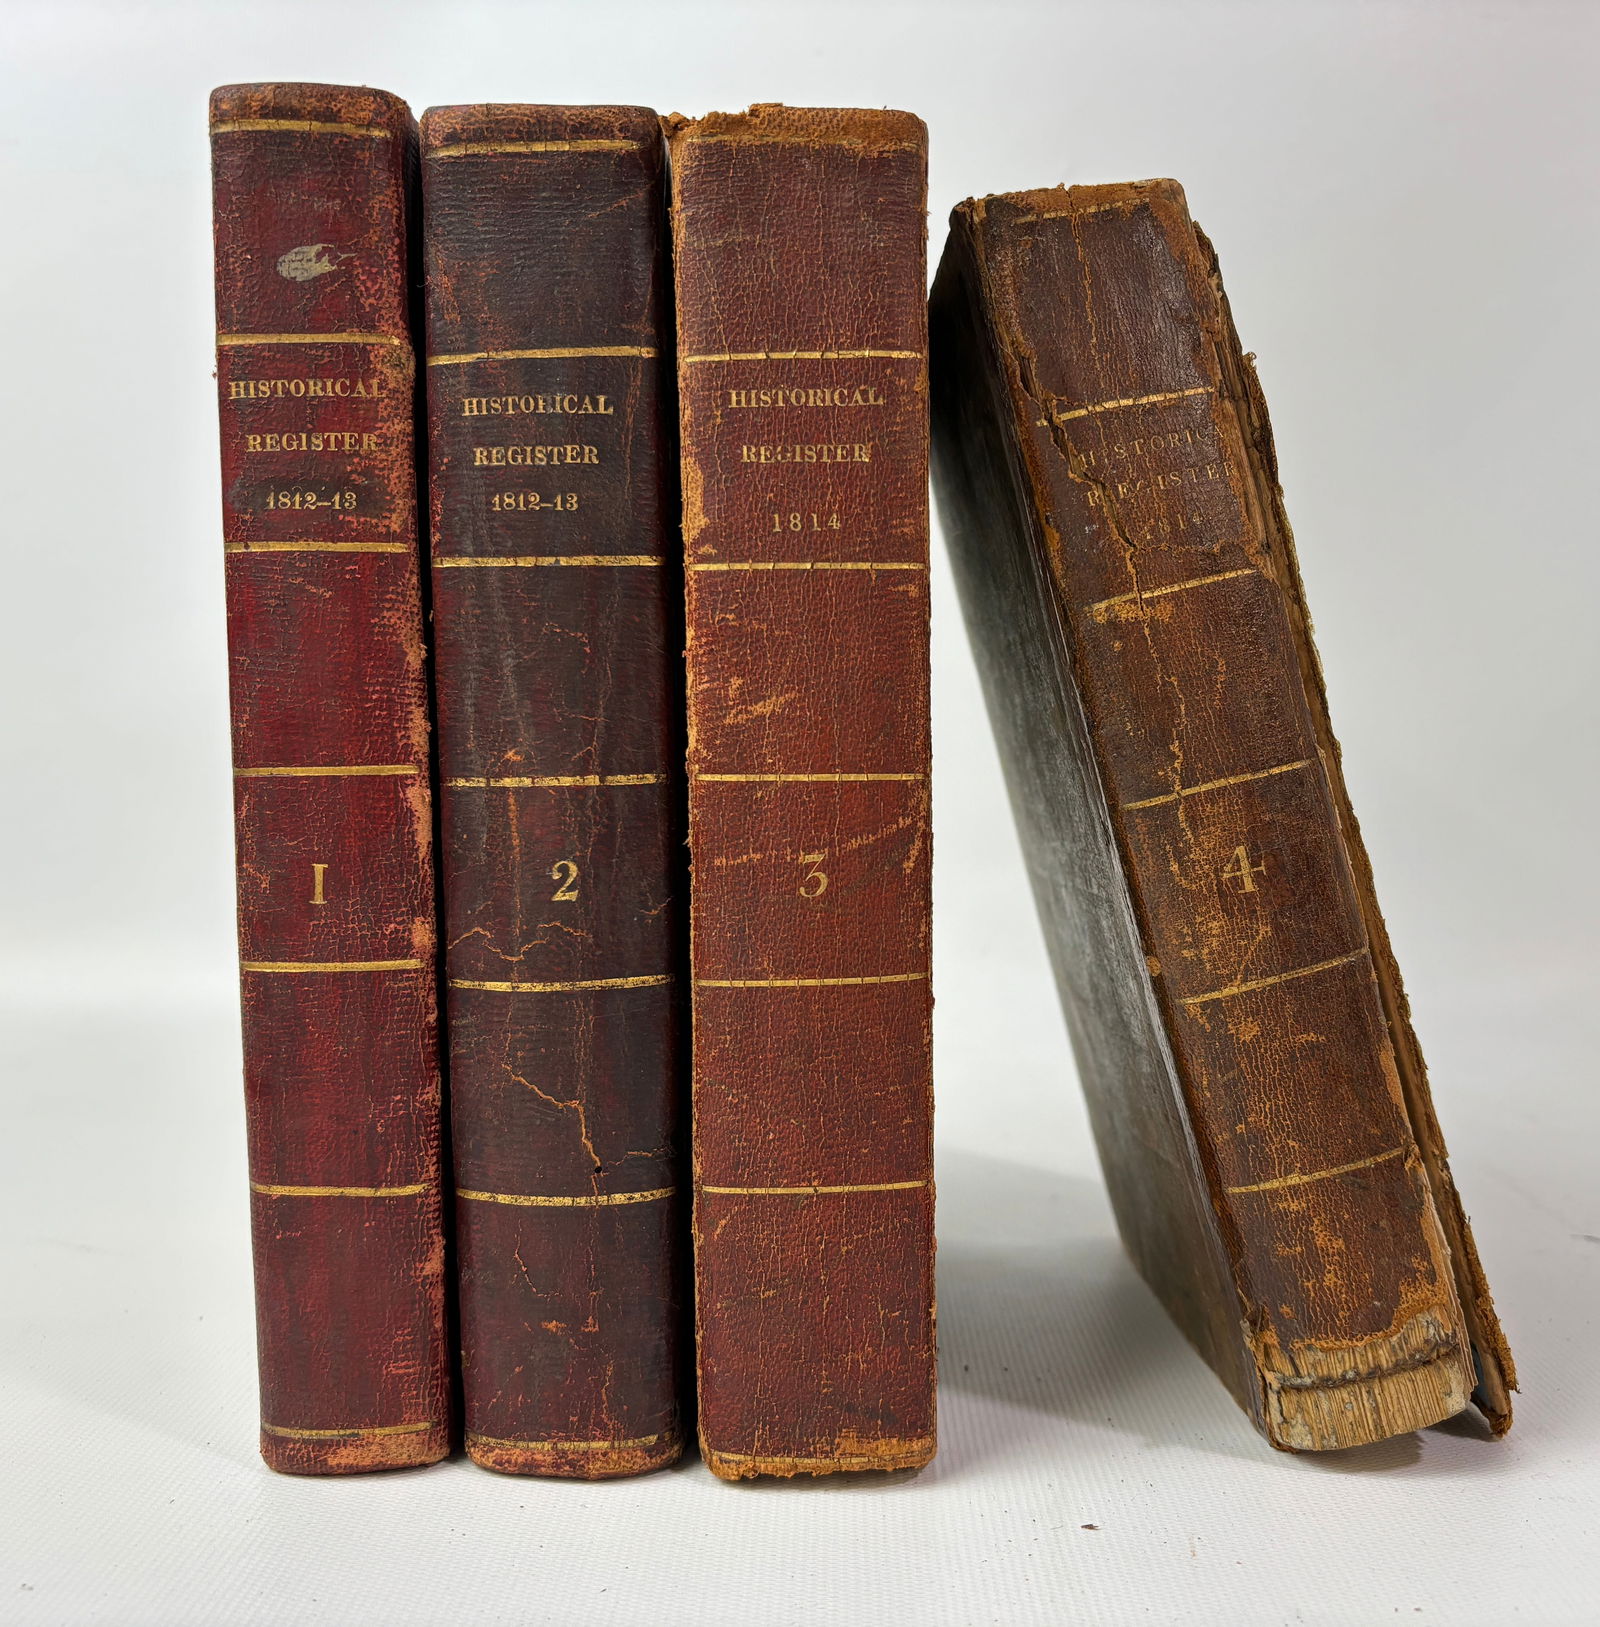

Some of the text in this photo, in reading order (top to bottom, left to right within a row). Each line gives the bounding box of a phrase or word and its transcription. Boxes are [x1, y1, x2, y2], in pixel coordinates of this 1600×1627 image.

[229, 378, 387, 399] HISTORICAL
[728, 387, 886, 408] HISTORICAL
[462, 394, 614, 416] HISTORICAL
[245, 432, 378, 453] REGISTER
[473, 444, 600, 466] REGISTER
[740, 443, 873, 464] REGISTER
[772, 512, 841, 532] 1814
[799, 853, 829, 898] 3
[1219, 845, 1265, 894] 4
[550, 860, 580, 902] 2
